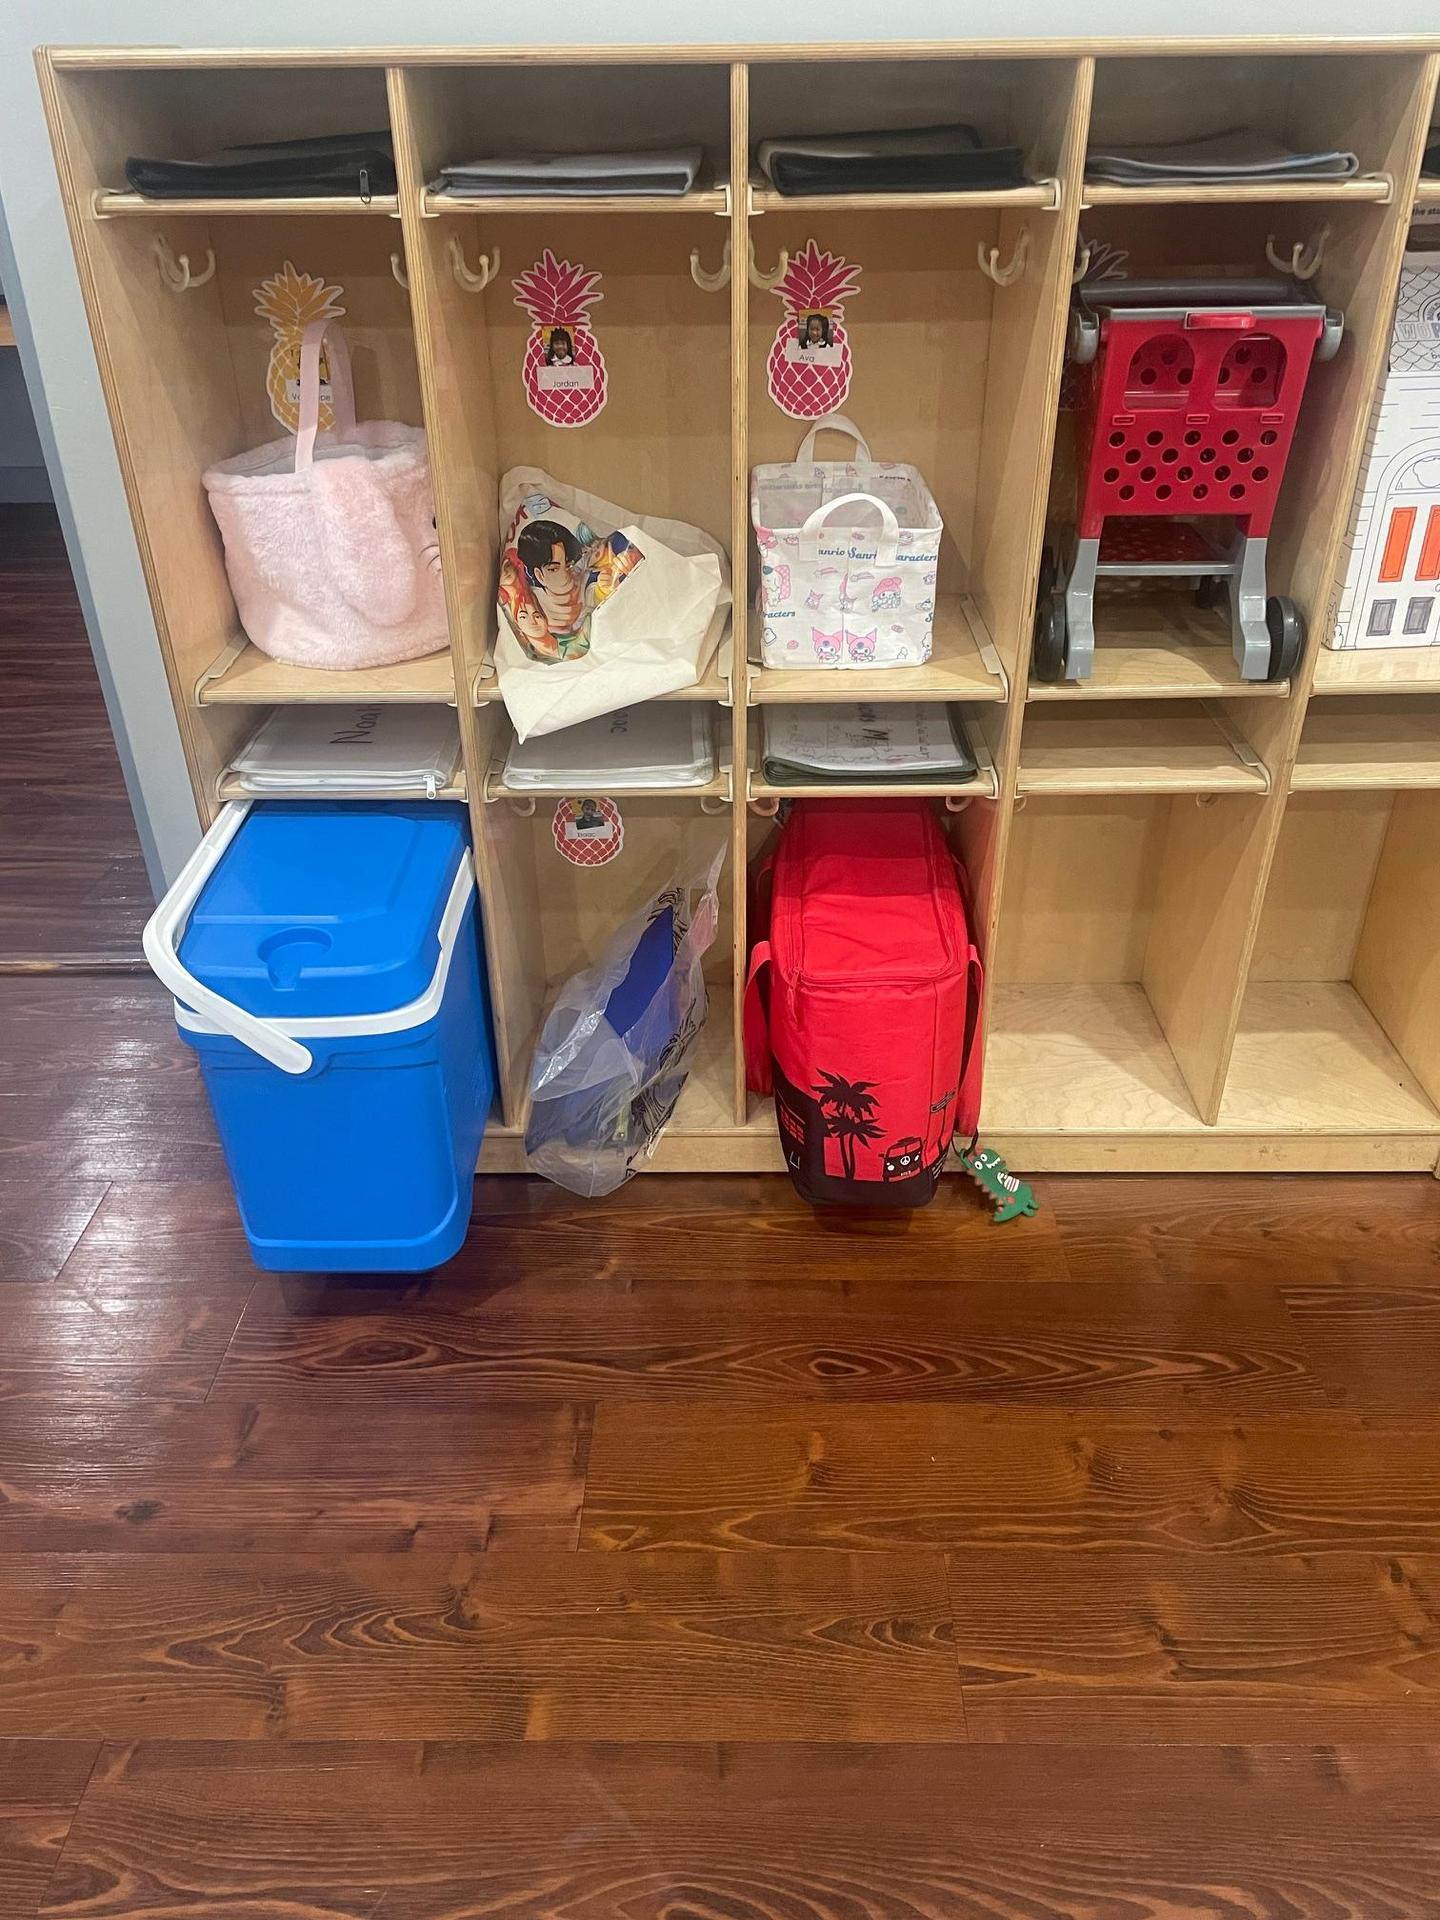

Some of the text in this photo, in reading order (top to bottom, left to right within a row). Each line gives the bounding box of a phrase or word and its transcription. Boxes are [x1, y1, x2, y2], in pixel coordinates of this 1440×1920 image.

[799, 354, 815, 362] Ava
[553, 380, 579, 388] Jordan
[817, 547, 845, 556] anrio
